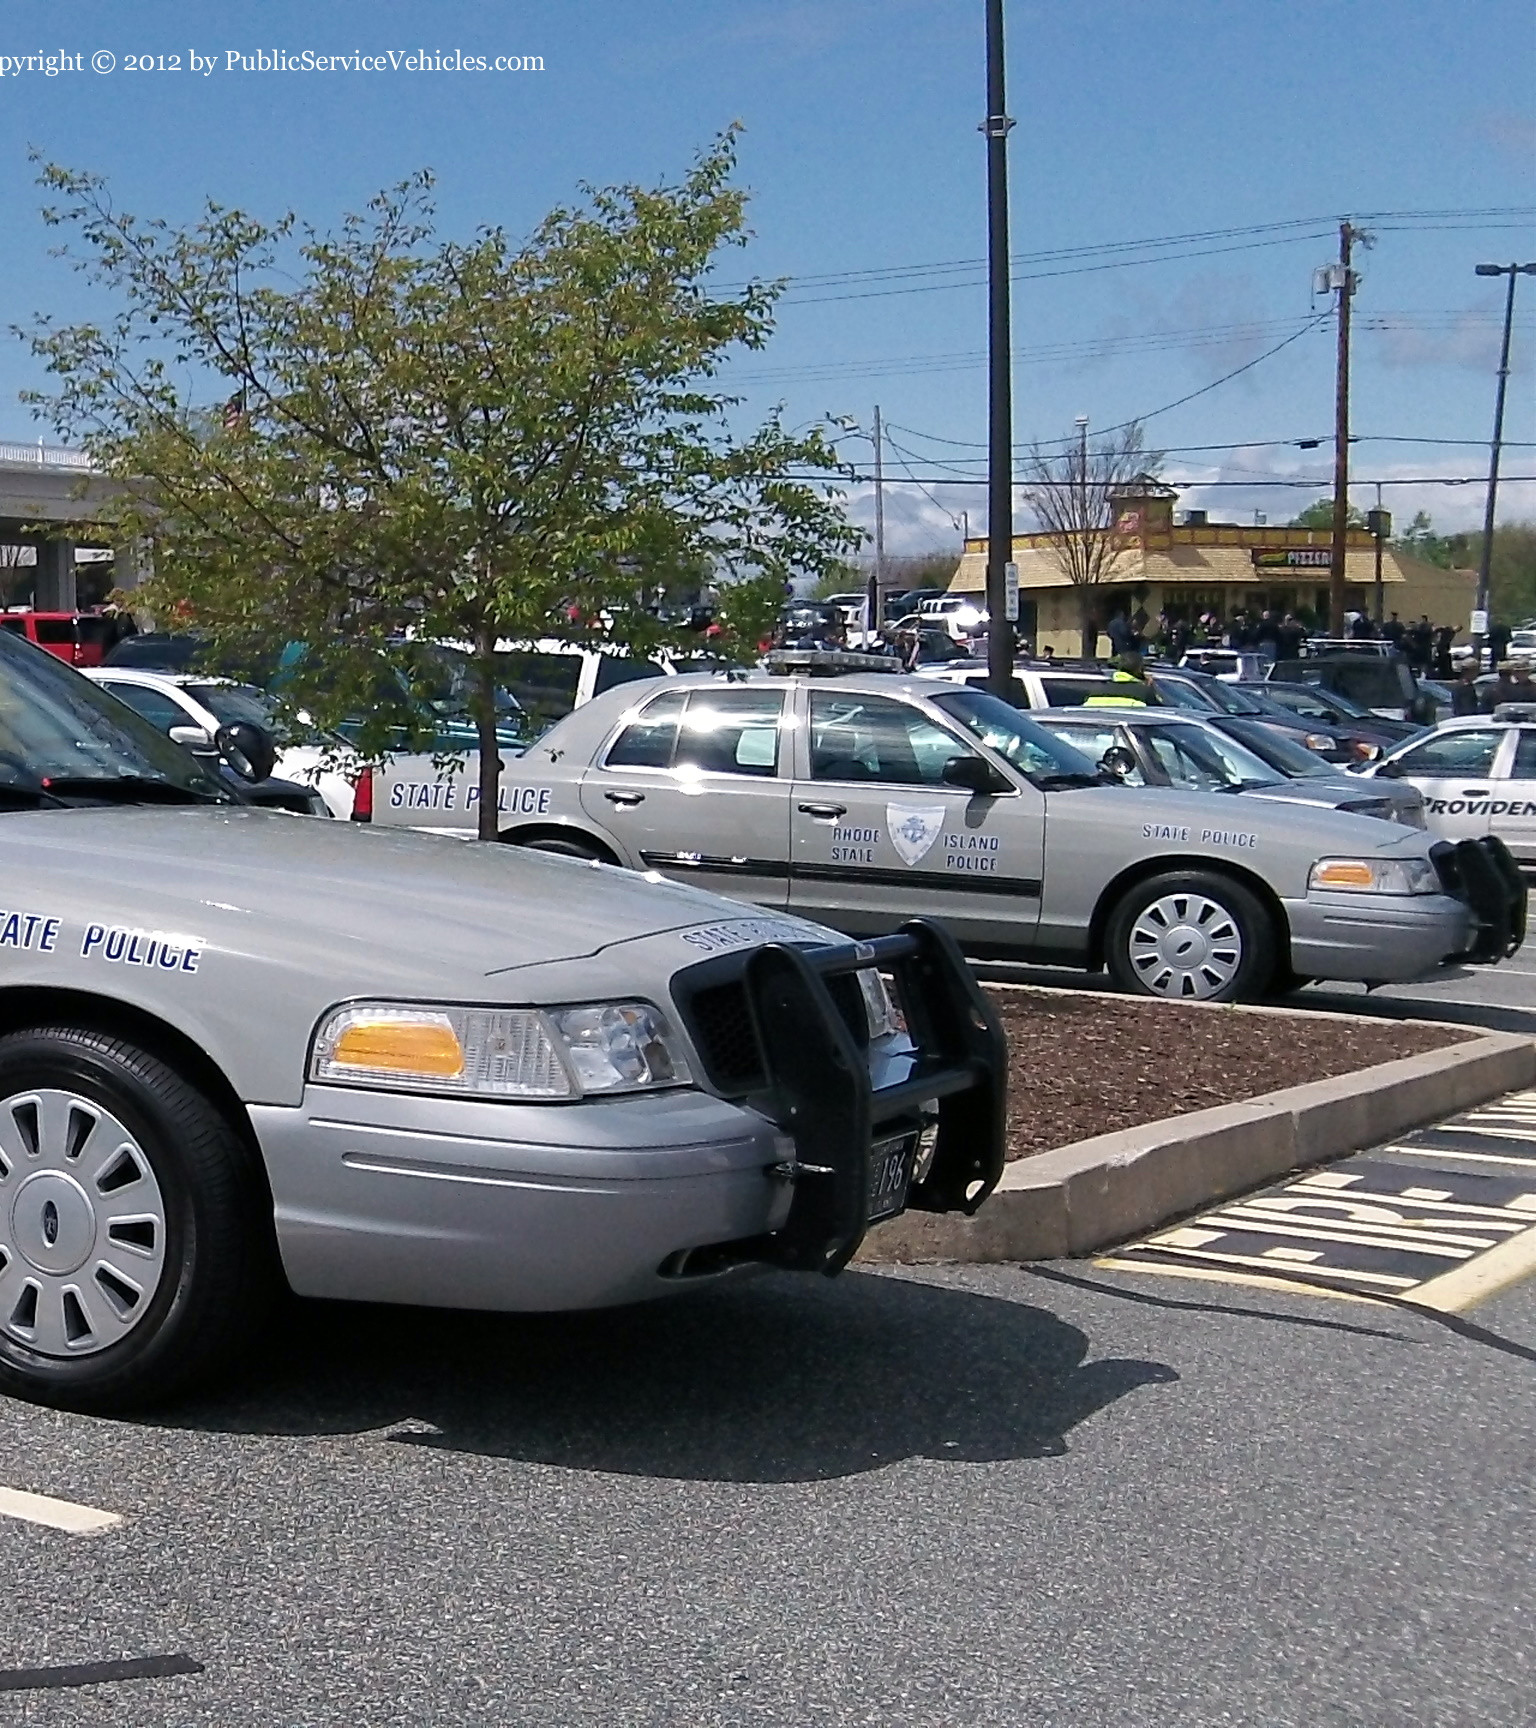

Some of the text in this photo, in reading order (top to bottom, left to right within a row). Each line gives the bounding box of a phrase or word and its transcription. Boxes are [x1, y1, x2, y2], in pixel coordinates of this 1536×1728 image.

[390, 782, 552, 815] STATE PLICE
[832, 826, 999, 851] RHODE ISLAND
[1142, 823, 1257, 848] STATE POLICE
[831, 847, 997, 872] STATE POLICE
[80, 922, 206, 974] POLICE
